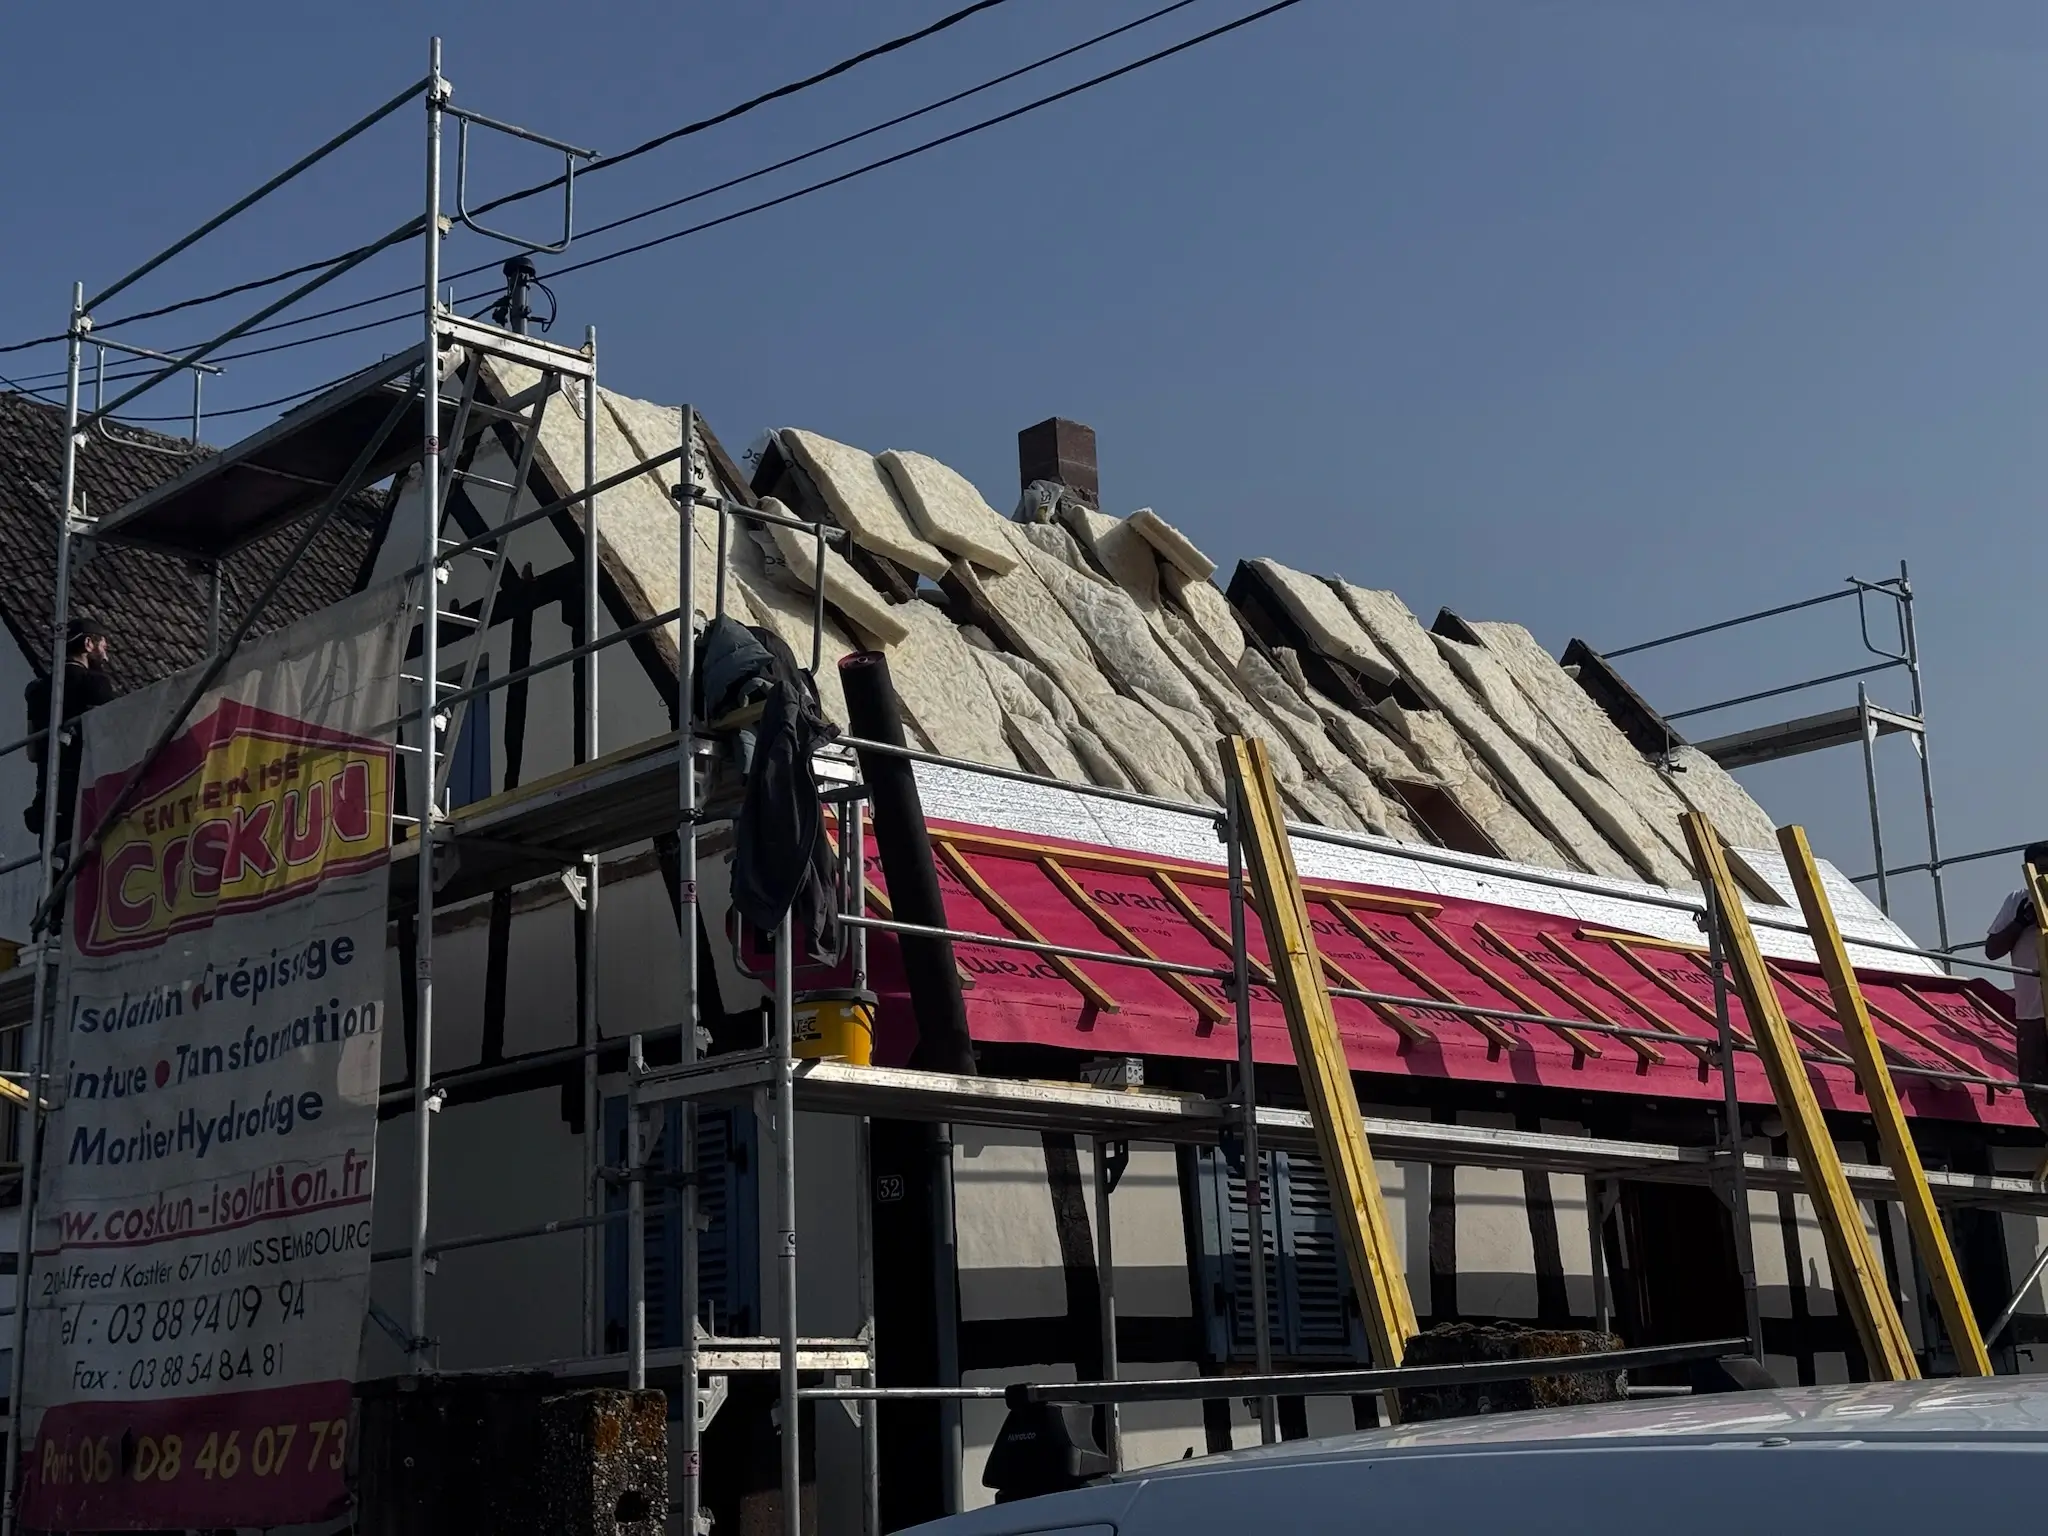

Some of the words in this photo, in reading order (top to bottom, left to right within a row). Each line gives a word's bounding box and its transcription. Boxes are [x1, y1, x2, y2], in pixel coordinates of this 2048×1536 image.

[69, 987, 182, 1034] Isolation
[178, 1090, 323, 1157] Hydrofuge
[880, 1178, 900, 1198] 32
[179, 1247, 231, 1281] 67160
[107, 1302, 147, 1344] 03
[152, 1298, 184, 1342] 88
[278, 1279, 305, 1323] 94
[73, 1360, 107, 1390] Fax
[129, 1358, 157, 1390] 03
[160, 1355, 184, 1387] 88
[188, 1352, 212, 1385] 54
[219, 1347, 253, 1381] 84
[263, 1343, 284, 1376] 81
[79, 1436, 114, 1483] 06
[195, 1430, 241, 1480] 46
[252, 1423, 297, 1477] 07
[307, 1418, 348, 1473] 73
